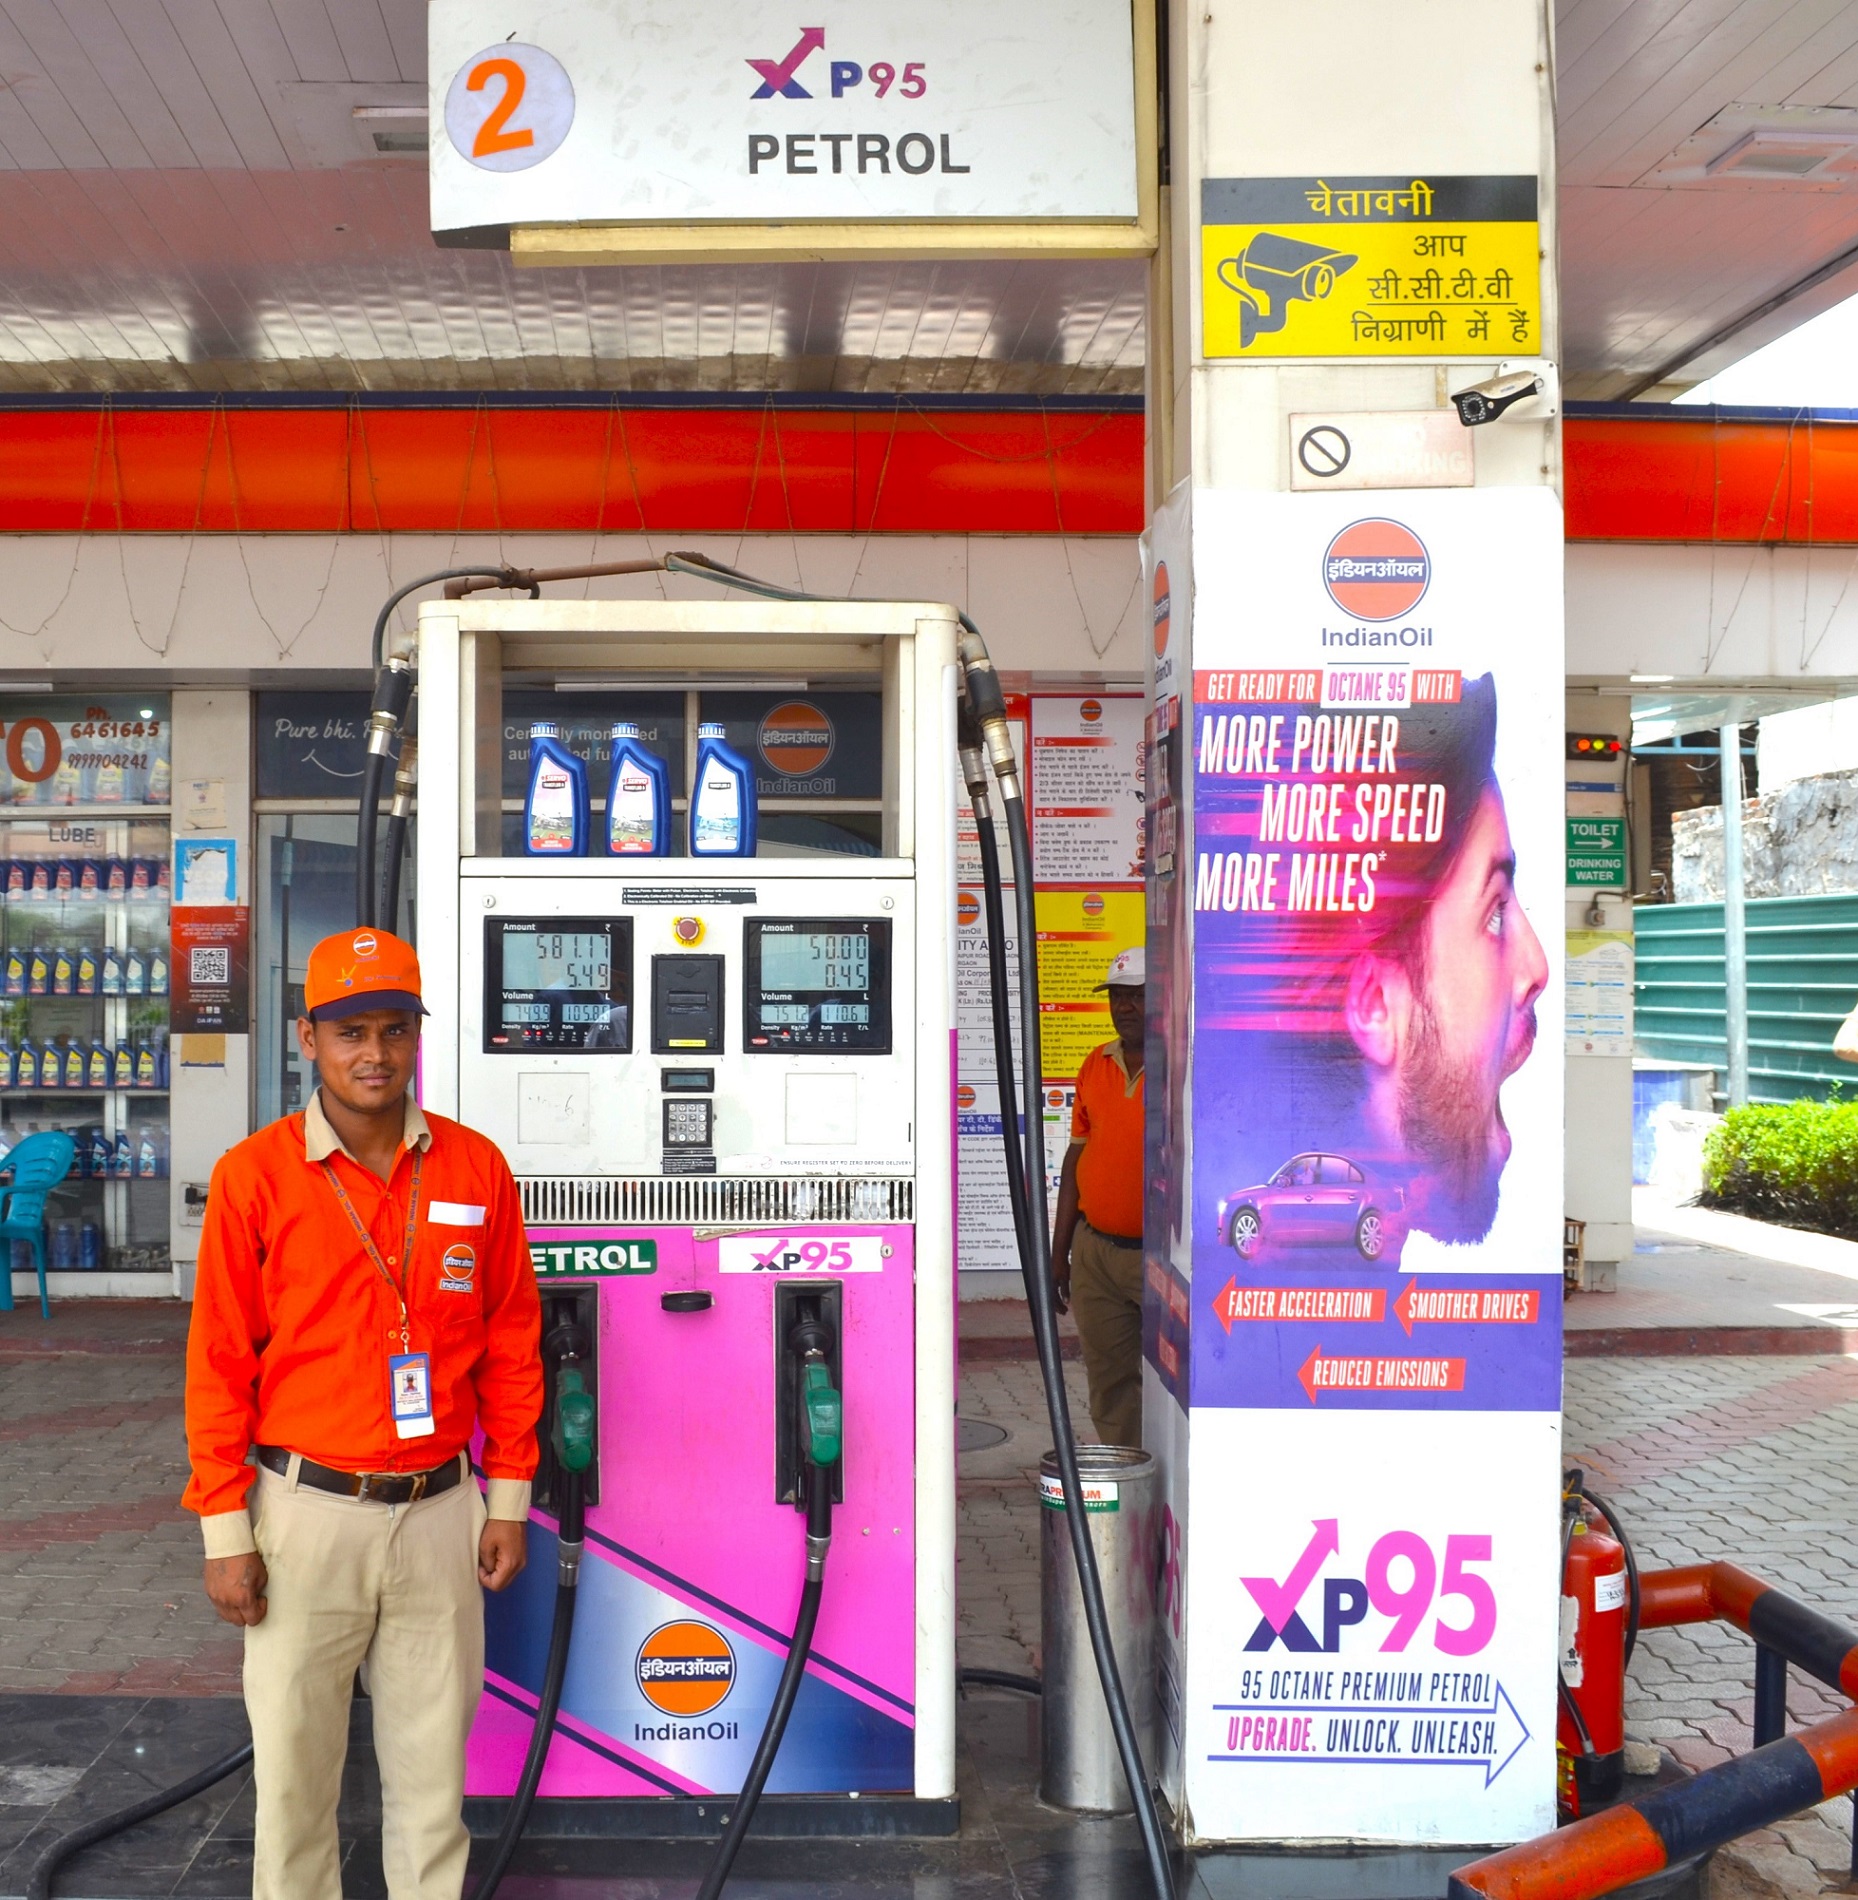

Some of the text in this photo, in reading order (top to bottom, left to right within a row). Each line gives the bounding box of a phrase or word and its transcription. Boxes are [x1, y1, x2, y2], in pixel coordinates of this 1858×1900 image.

[465, 57, 535, 158] 2
[749, 133, 970, 175] PETROL
[1305, 179, 1435, 217] चेतावनी
[1413, 234, 1467, 257] आप
[1466, 309, 1490, 341] में
[1508, 309, 1530, 342] हैं
[1328, 557, 1425, 580] इंडियनऑयल
[1321, 627, 1433, 647] IndianOil
[1207, 671, 1455, 701] GET READY FOR OCTANE 95 WITH
[86, 706, 112, 721] Ph.
[70, 720, 161, 738] 6461645
[275, 718, 319, 738] Pure
[762, 730, 829, 746] इंडियनऑयल
[1198, 715, 1399, 775] MORE POWER
[756, 777, 836, 794] IndianOil
[1259, 783, 1446, 843] MORE SPEED
[49, 827, 95, 842] LUBE
[1570, 823, 1620, 836] TOILET
[1568, 858, 1622, 869] DRINKING
[1194, 852, 1280, 912] MORE
[1575, 870, 1614, 881] WATER
[503, 923, 536, 931] Amount
[761, 924, 794, 932] Amount
[537, 935, 609, 959] 581.17
[811, 936, 866, 960] 50.00
[958, 940, 976, 950] ITY
[567, 963, 609, 988] 5.49
[826, 964, 866, 988] 0.45
[502, 992, 534, 1000] Volume
[515, 1005, 550, 1021] 749.9
[774, 1006, 808, 1021] 751.2
[533, 1245, 651, 1272] ETROL
[750, 1238, 853, 1272] XP95
[1227, 1291, 1373, 1319] FASTER ACCELERATION
[1408, 1292, 1530, 1320] SMOOTHER DRIVES
[1312, 1358, 1449, 1388] REDUCED EMISSIONS
[1239, 1518, 1498, 1657] XP95
[640, 1658, 731, 1680] इंडियनऑयल
[1240, 1671, 1492, 1703] 95 OCTANE PREMIUM PETROL
[635, 1722, 738, 1741] IndianOil
[1227, 1716, 1498, 1756] UPGRADE. UNLOCK. UNLEASH.
